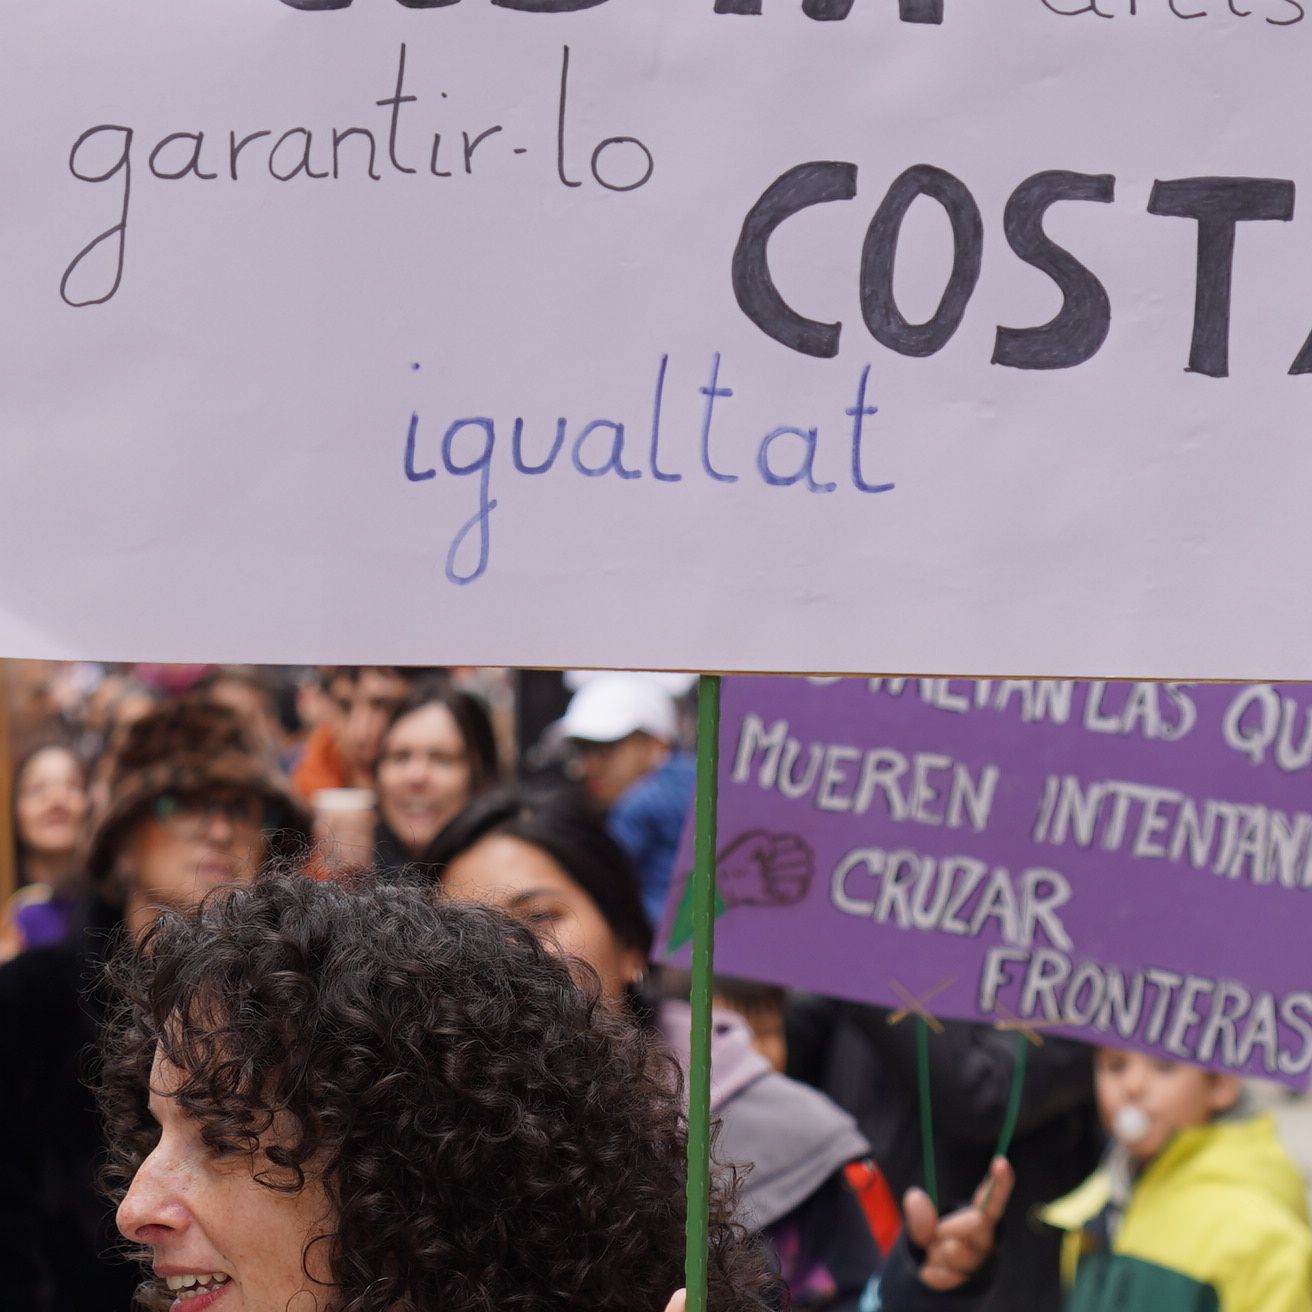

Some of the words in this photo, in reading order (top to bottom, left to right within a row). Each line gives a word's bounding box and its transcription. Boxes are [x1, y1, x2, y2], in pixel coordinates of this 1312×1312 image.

[59, 42, 655, 308] garantir-lo
[402, 352, 896, 586] igualtat
[1085, 678, 1196, 741] LAS
[732, 713, 999, 832] MUEREN
[830, 846, 1074, 952] CRUZAR
